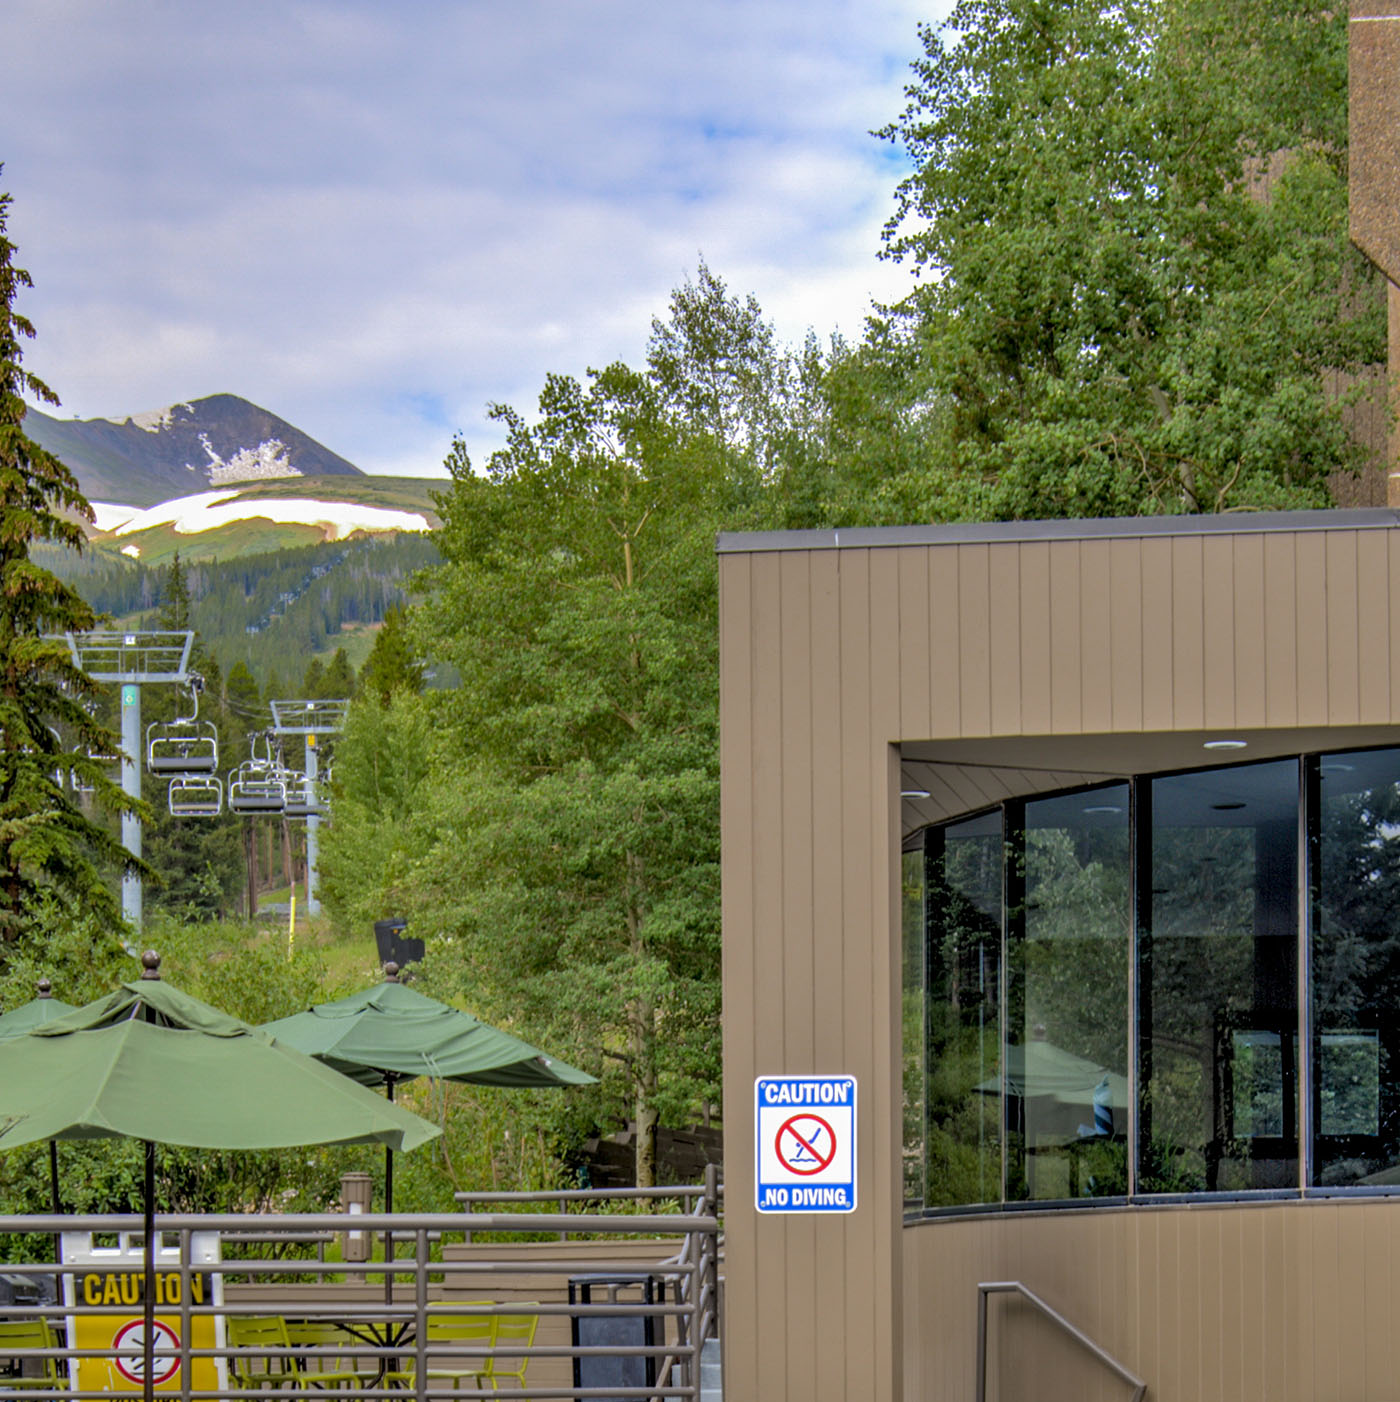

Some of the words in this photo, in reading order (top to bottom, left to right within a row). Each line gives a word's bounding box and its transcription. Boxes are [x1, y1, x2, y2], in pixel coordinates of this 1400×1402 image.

[765, 1083, 847, 1104] CAUTION
[765, 1188, 788, 1206] NO
[792, 1188, 846, 1206] DIVING
